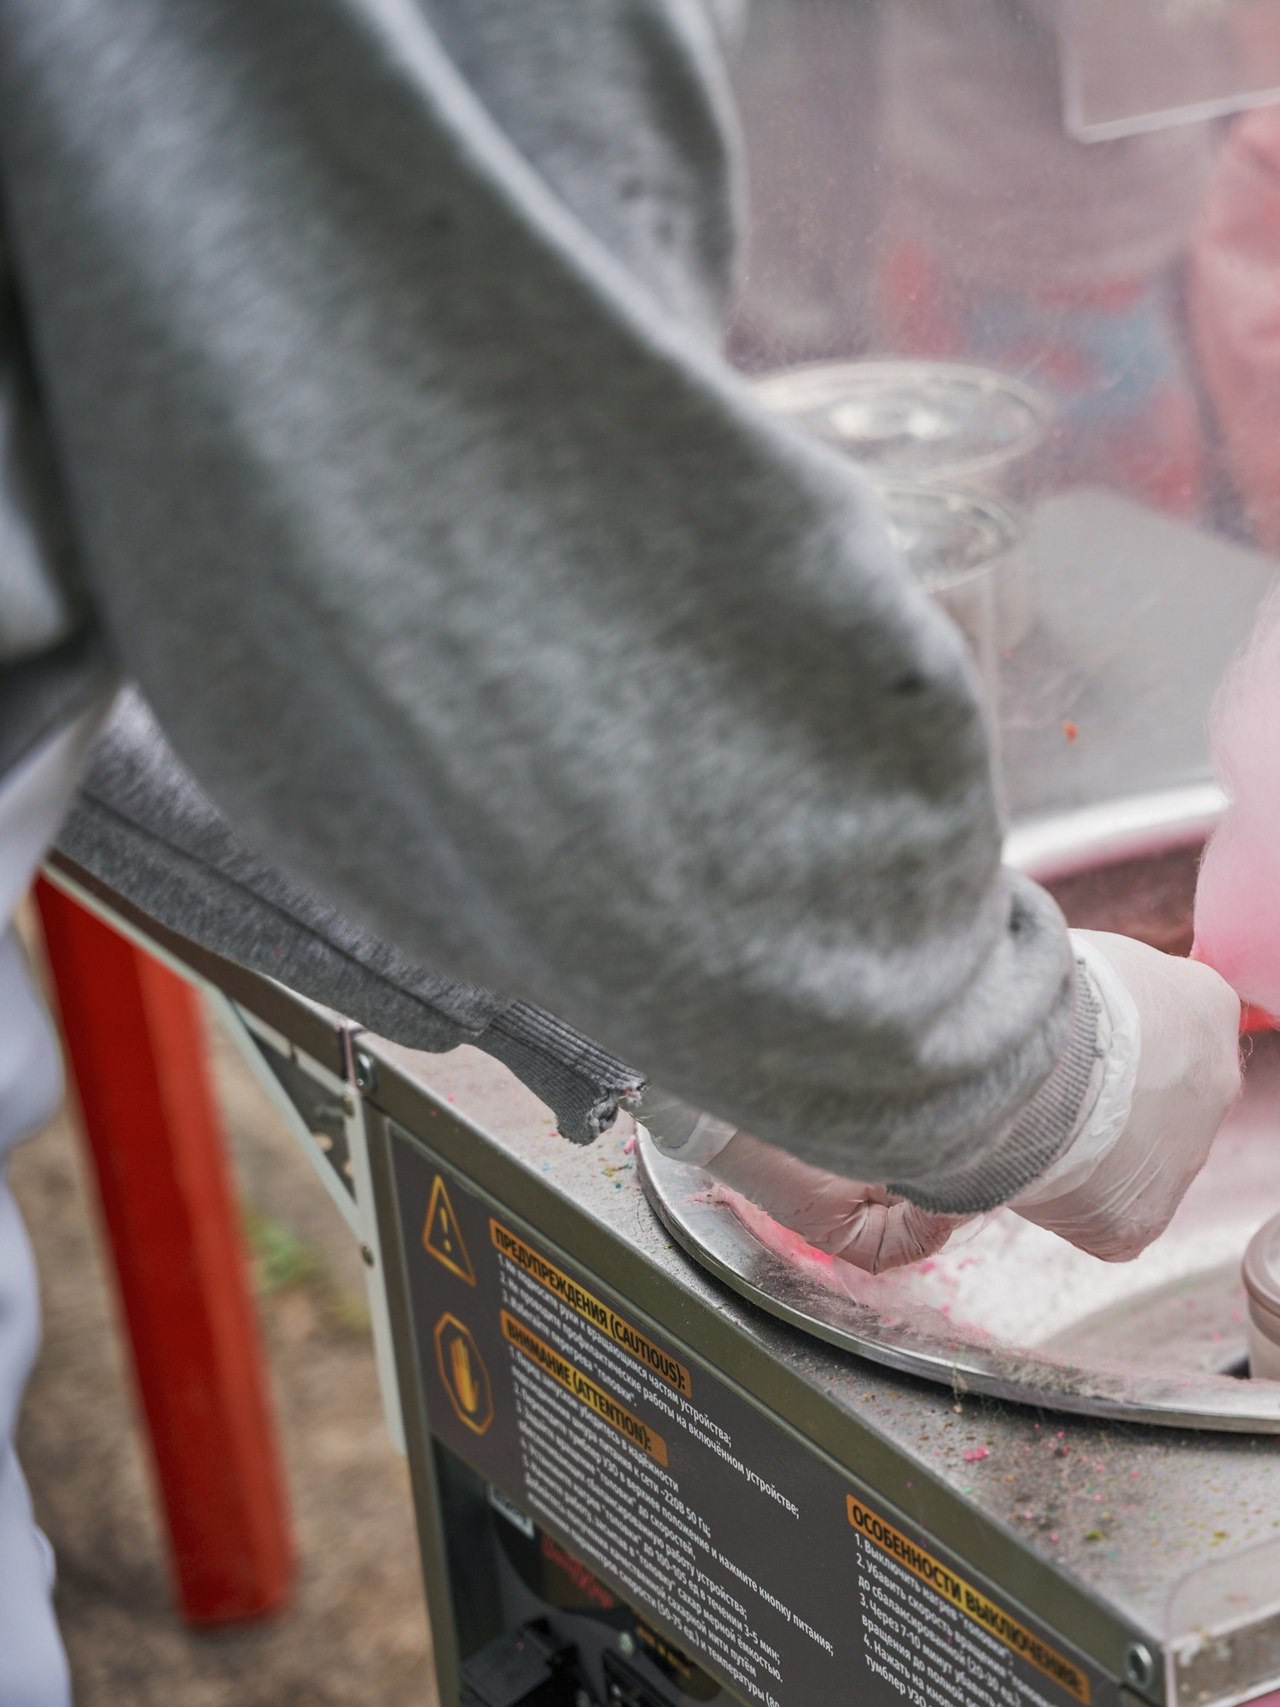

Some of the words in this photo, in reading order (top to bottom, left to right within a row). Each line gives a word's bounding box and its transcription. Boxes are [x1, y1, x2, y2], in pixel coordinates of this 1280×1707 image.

[497, 1229, 608, 1324] ПРЕДУПРЕЖДЕНИЯ
[610, 1314, 685, 1390] (CAUTIOUS):
[509, 1319, 571, 1385] ВНИМАНИЕ
[573, 1371, 652, 1452] (ATTENTION):
[559, 1304, 579, 1325] руки
[587, 1325, 648, 1380] вращающимся
[649, 1374, 679, 1404] частям
[680, 1398, 732, 1448] устройства;
[562, 1323, 641, 1393] профилактические
[643, 1387, 674, 1419] работы
[688, 1423, 745, 1474] включённом
[745, 1467, 799, 1519] устройстве;
[628, 1445, 679, 1492] надёжности
[640, 1472, 659, 1494] сети
[698, 1517, 711, 1539] Гц;
[626, 1477, 660, 1512] верхнее
[662, 1507, 710, 1553] положение
[719, 1553, 757, 1592] нажмите
[759, 1586, 791, 1622] кнопку
[793, 1614, 834, 1656] питания;
[650, 1514, 696, 1560] скоростей,
[853, 1505, 961, 1601] ОСОБЕННОСТИ
[864, 1539, 921, 1592] Выключить
[655, 1550, 687, 1585] 100-105
[707, 1595, 743, 1632] течении
[744, 1624, 758, 1644] 3-5
[760, 1639, 780, 1665] мин;
[665, 1544, 695, 1577] работу
[696, 1569, 747, 1620] устройства;
[866, 1560, 906, 1600] Убавить
[908, 1595, 952, 1637] скорость
[667, 1595, 707, 1635] сахарной
[708, 1630, 729, 1654] нити
[730, 1649, 756, 1677] путём
[678, 1588, 702, 1615] сахар
[703, 1609, 736, 1643] мерной
[737, 1634, 783, 1683] ёмкостью.
[862, 1614, 911, 1661] вращения
[927, 1666, 964, 1702] полной
[869, 1600, 899, 1633] Через
[900, 1624, 921, 1649] 7-10
[872, 1586, 965, 1665] сбалансированной
[874, 1640, 910, 1679] Нажать
[707, 1645, 765, 1701] температуры
[865, 1654, 906, 1695] тумблер
